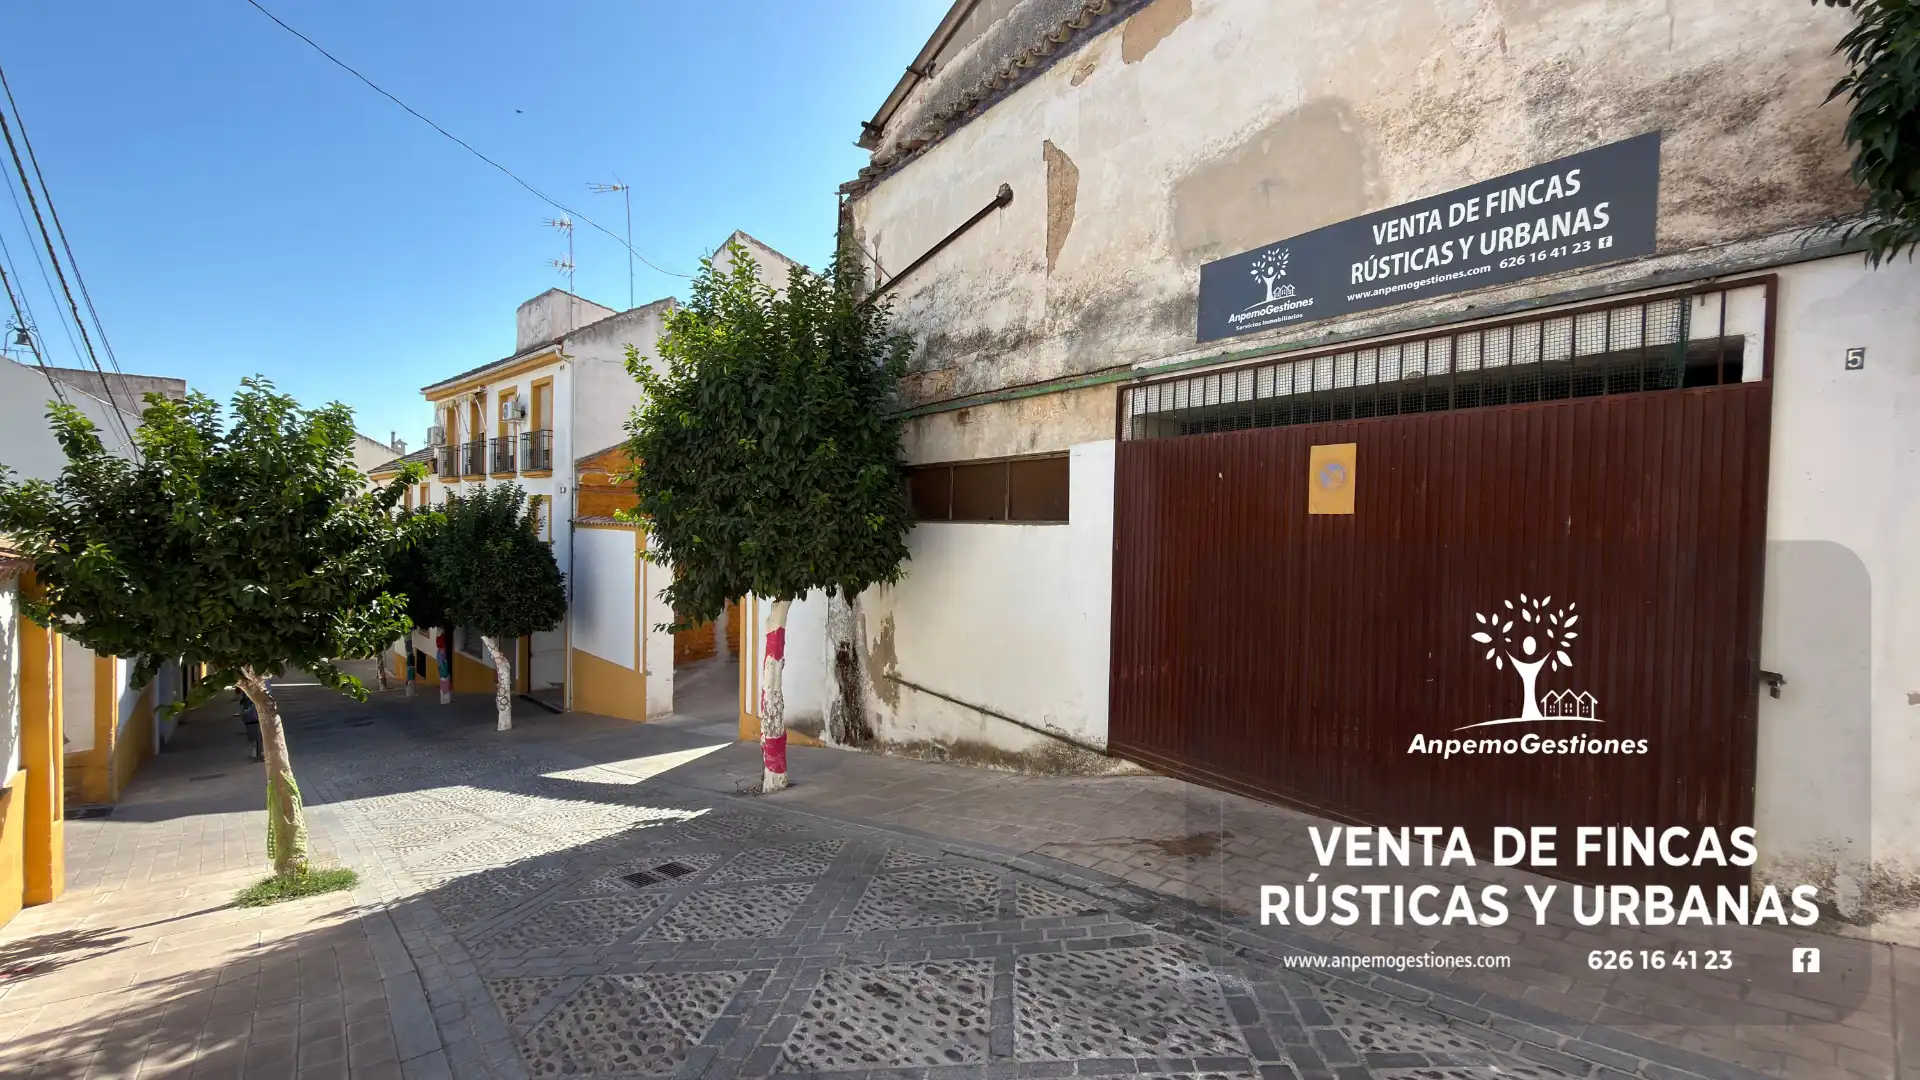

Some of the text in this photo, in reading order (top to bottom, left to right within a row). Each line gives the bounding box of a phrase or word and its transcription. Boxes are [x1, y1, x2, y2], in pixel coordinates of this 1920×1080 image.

[1372, 168, 1582, 246] VENTA DE FINCAS
[1346, 264, 1492, 302] www.anpemogestiones.com
[1499, 256, 1526, 270] 626
[1529, 251, 1547, 264] 16
[1549, 246, 1568, 259] 41
[1572, 240, 1592, 255] 23
[1350, 201, 1611, 285] RÚSTICAS Y URBANAS
[1227, 297, 1315, 324] AnpemoGestiones
[1848, 349, 1862, 368] 5
